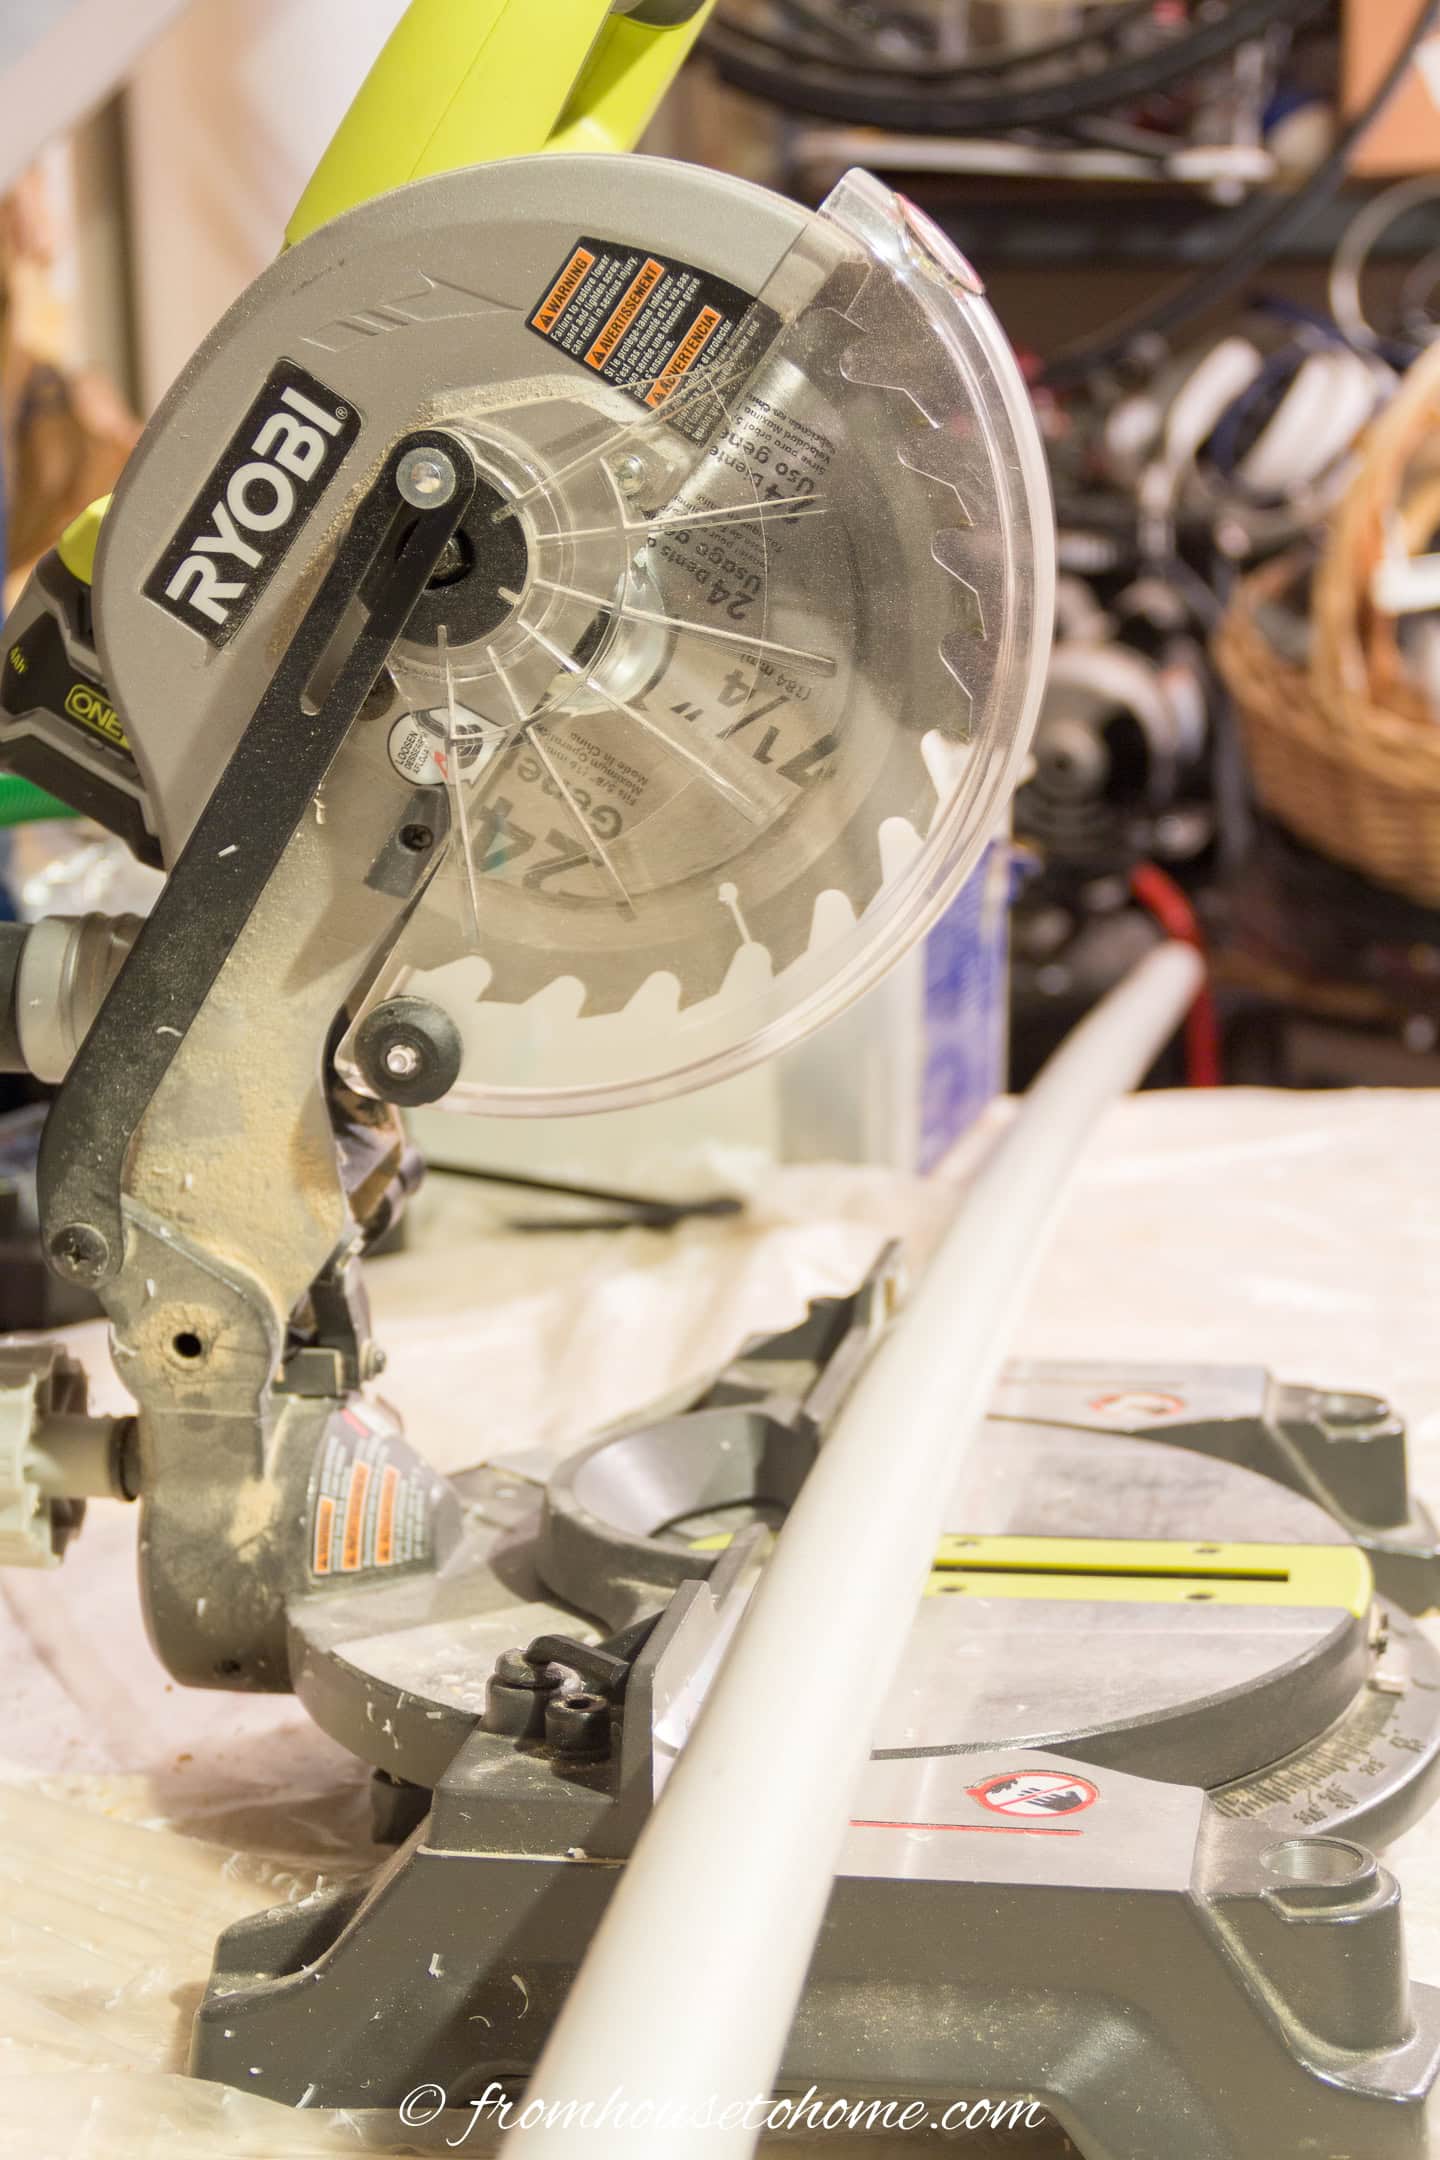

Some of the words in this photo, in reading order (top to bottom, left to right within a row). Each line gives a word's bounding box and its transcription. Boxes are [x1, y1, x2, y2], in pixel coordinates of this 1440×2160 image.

[544, 256, 588, 314] WARNING
[549, 311, 573, 341] Failure
[567, 302, 579, 314] to
[573, 275, 597, 306] restore
[590, 253, 611, 278] lower
[666, 286, 681, 301] vis
[675, 271, 691, 289] pas
[559, 323, 581, 350] guard
[573, 308, 589, 326] and
[583, 281, 608, 312] tighten
[601, 258, 622, 284] screw
[568, 337, 584, 355] can
[578, 315, 599, 340] result
[592, 306, 604, 318] in
[598, 278, 623, 309] serious
[616, 253, 639, 281] injury.
[596, 264, 659, 351] AVERTISSEMENT
[649, 331, 665, 349] une
[659, 298, 686, 334] blessure
[681, 276, 702, 302] grave
[655, 307, 667, 319] et
[661, 298, 673, 310] la
[658, 312, 716, 392] ADVERTENCIA
[704, 318, 734, 356] protector
[603, 365, 615, 377] Si
[609, 356, 621, 368] le
[613, 362, 631, 384] n'est
[625, 348, 642, 366] pas
[698, 352, 711, 364] el
[774, 460, 817, 496] Uso
[165, 386, 343, 624] RYOBI
[659, 545, 707, 583] Dents
[694, 540, 762, 595] Usage
[705, 576, 756, 622] 24
[71, 692, 123, 737] ONE
[393, 729, 419, 765] LOOSEN
[565, 729, 604, 758] China
[586, 757, 645, 797] Maximum
[613, 760, 650, 786] Made
